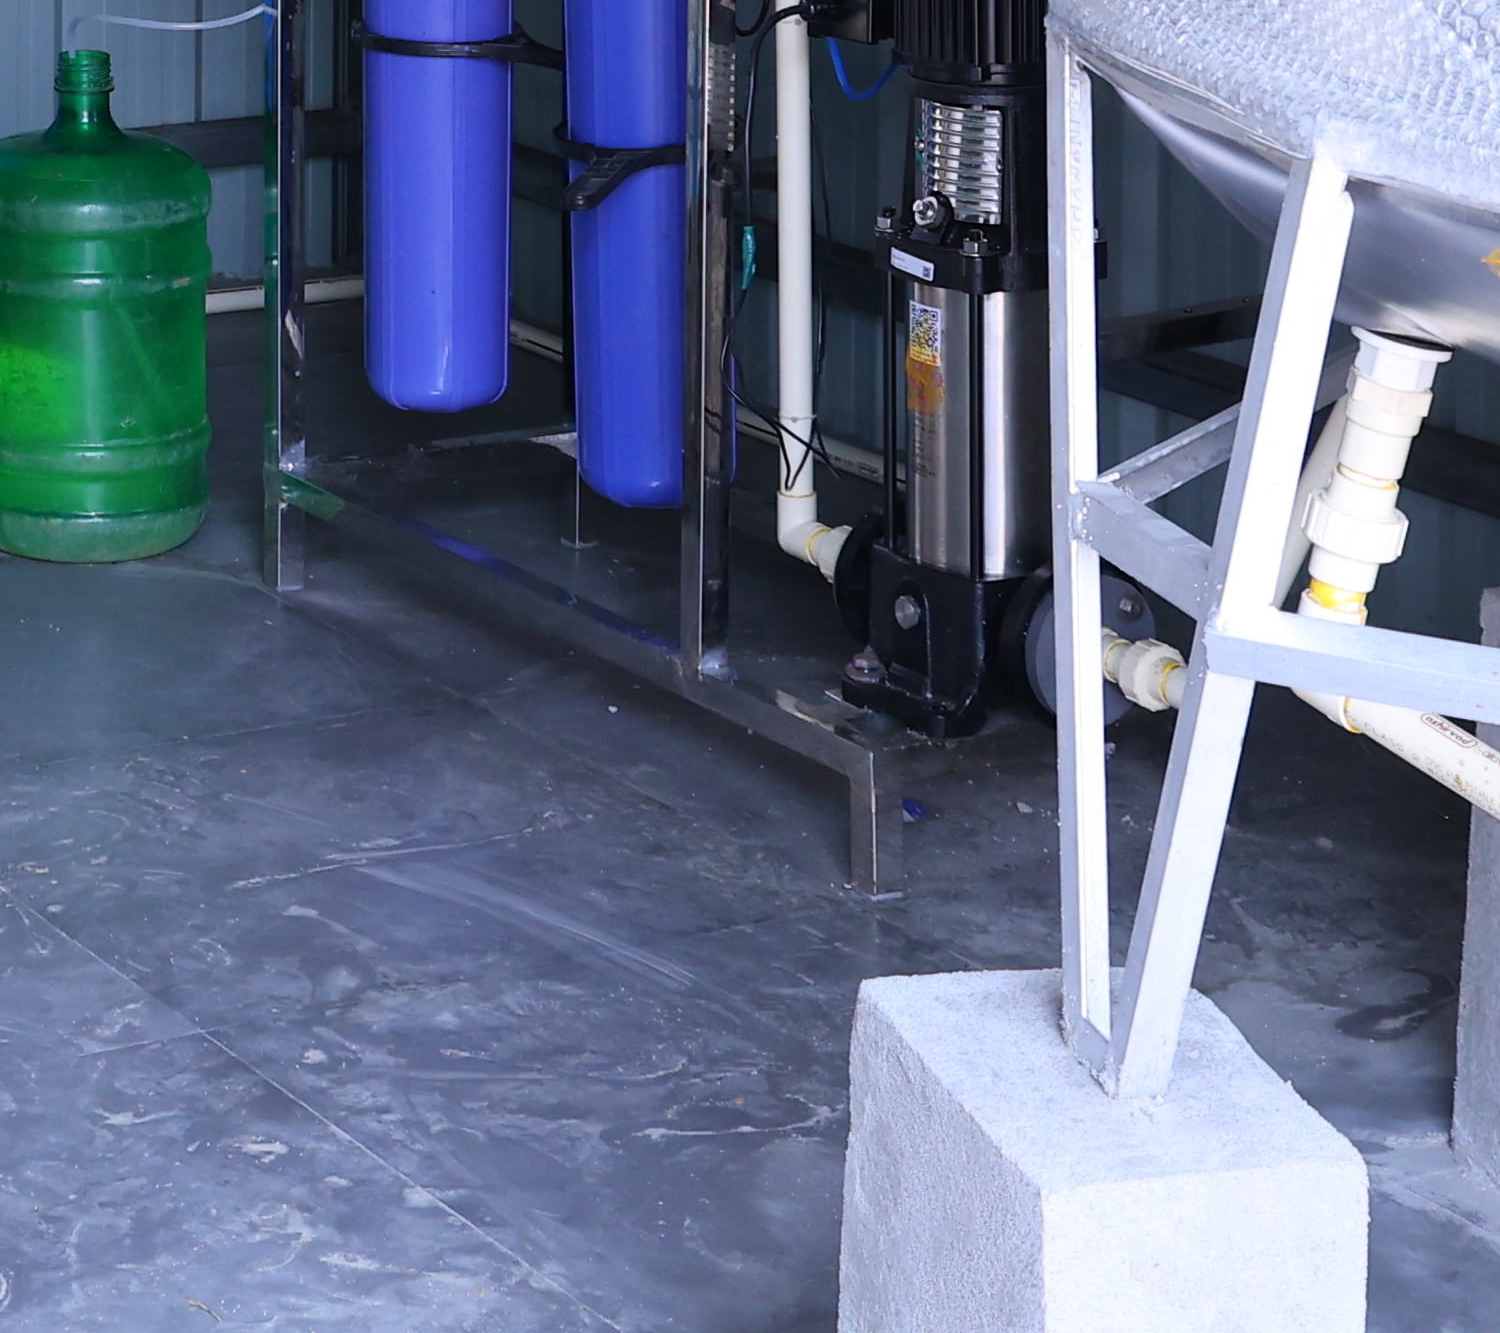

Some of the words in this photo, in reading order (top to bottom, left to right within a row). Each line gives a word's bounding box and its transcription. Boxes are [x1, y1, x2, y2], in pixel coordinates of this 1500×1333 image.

[1360, 721, 1407, 753] CLASS
[1409, 751, 1421, 762] 2
[1422, 711, 1475, 749] ashirvad
